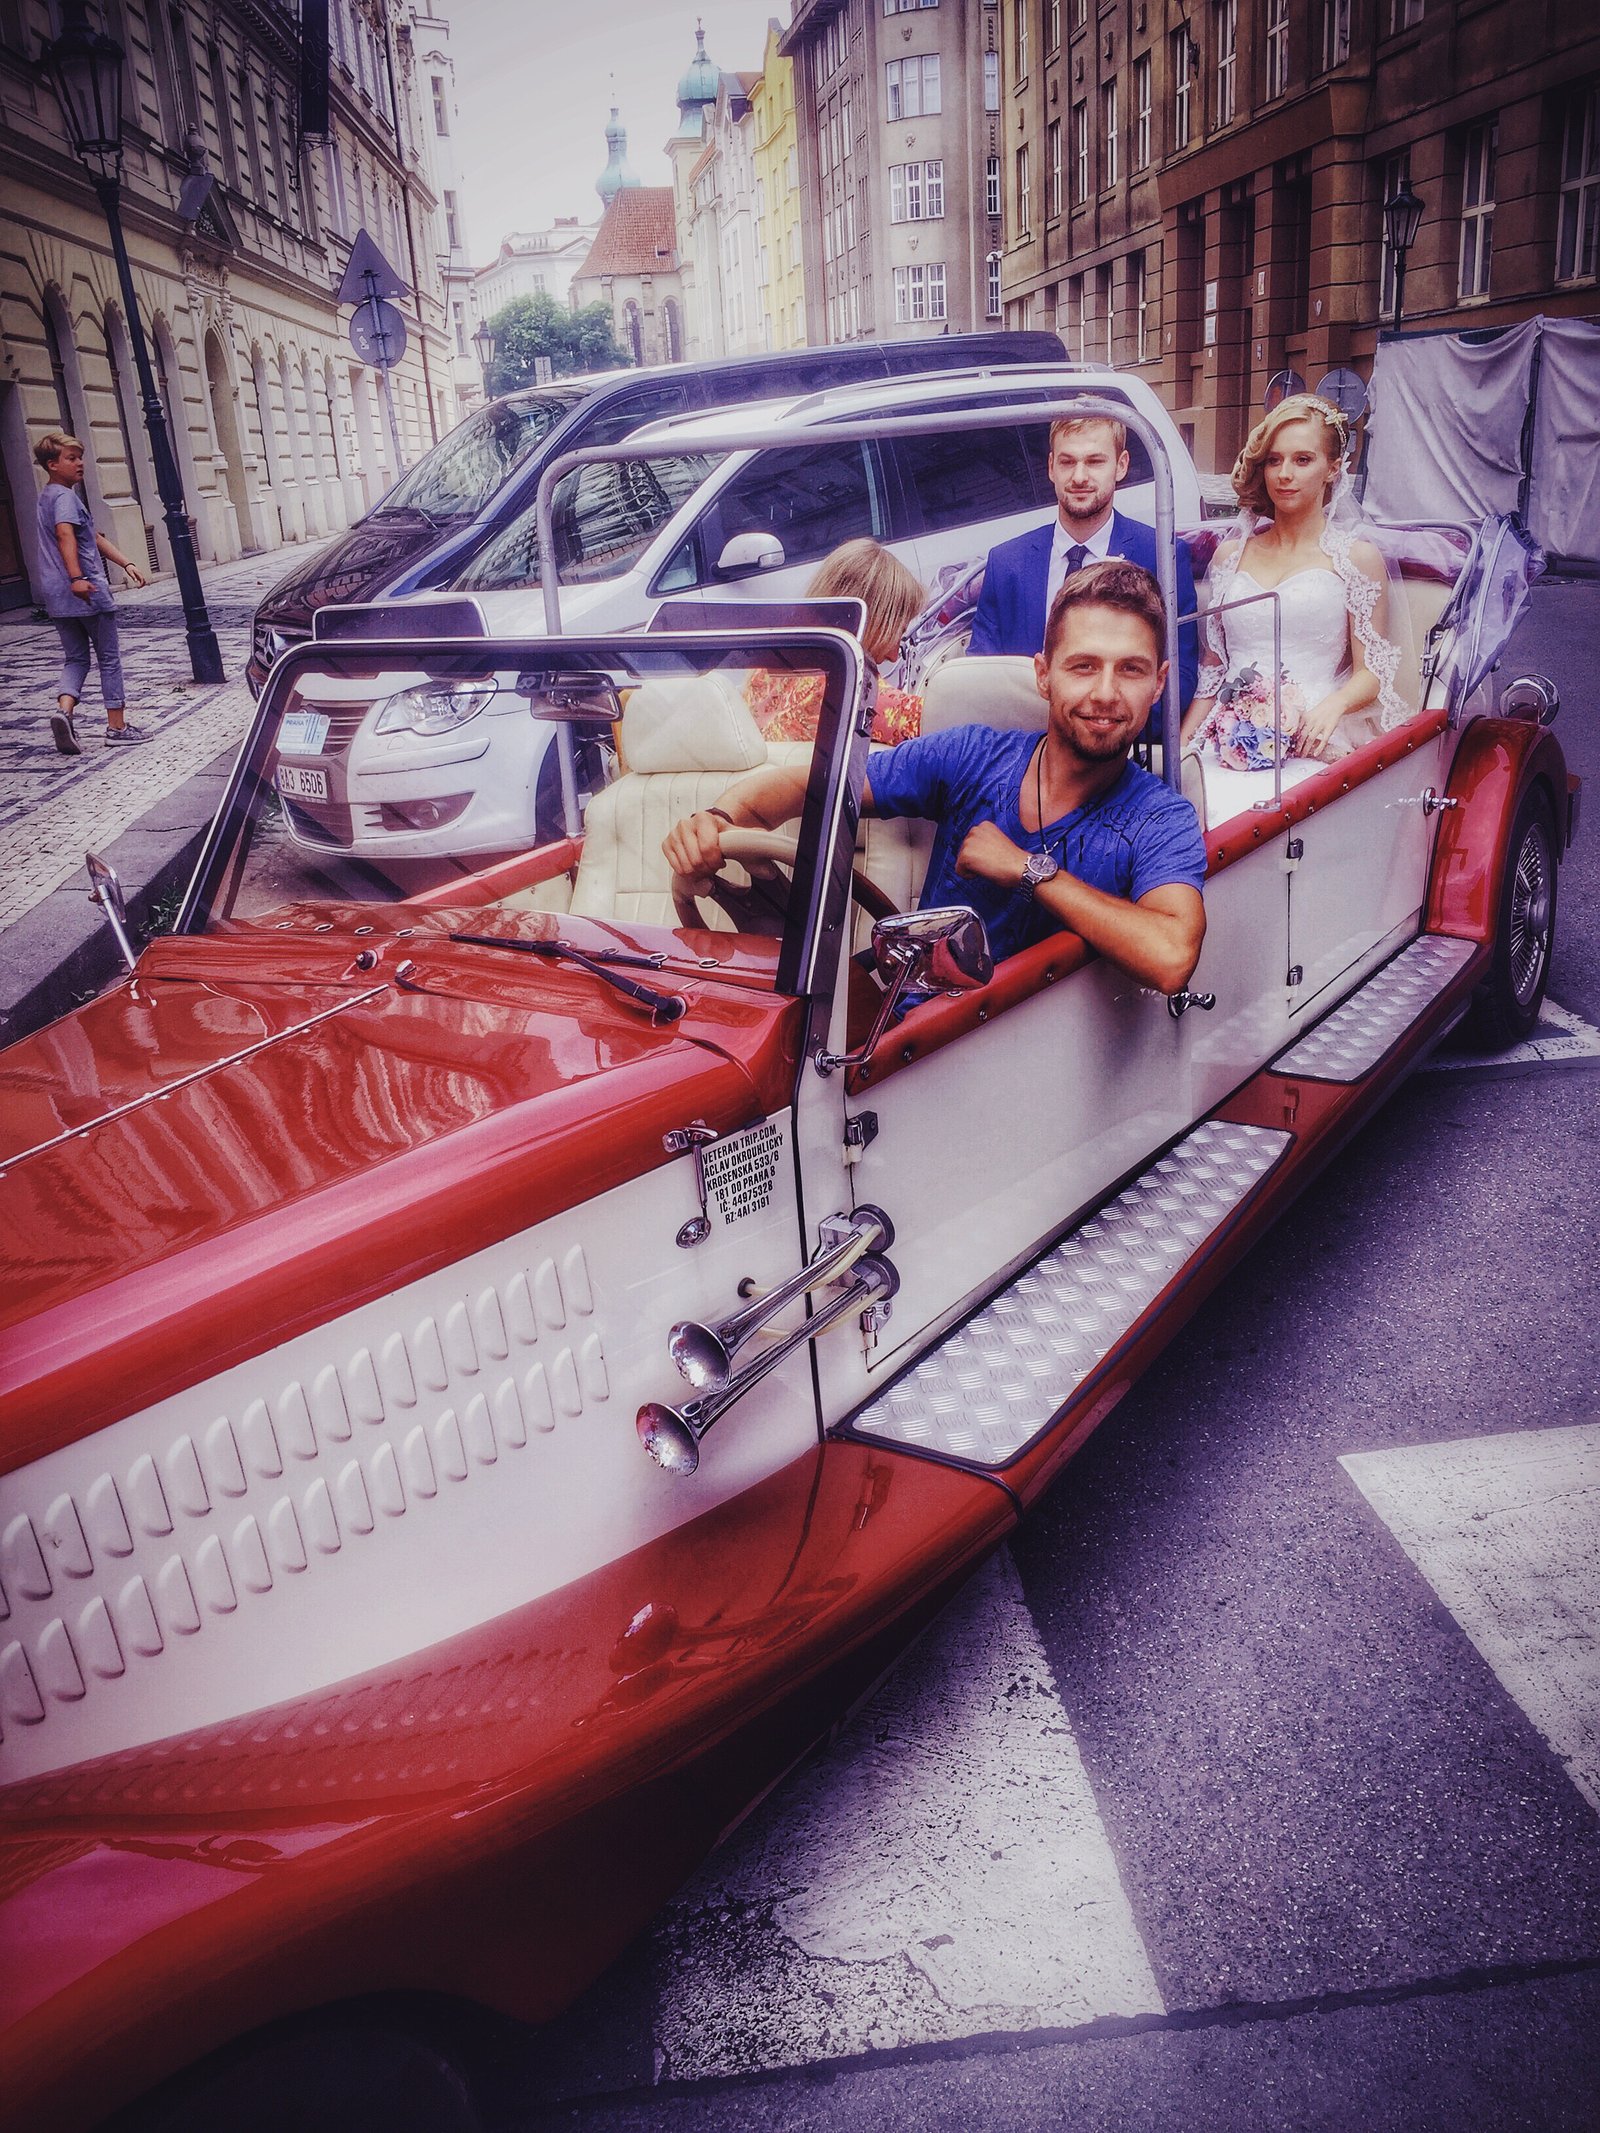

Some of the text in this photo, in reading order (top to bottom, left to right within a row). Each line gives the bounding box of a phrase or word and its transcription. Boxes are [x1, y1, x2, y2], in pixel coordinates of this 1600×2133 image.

[300, 771, 324, 795] 6506
[702, 1123, 777, 1165] VETERAN TRIP.COM
[703, 1132, 784, 1179] ÁCLAV OKROUHLICKÝ
[706, 1160, 754, 1192] KROSENSKÁ
[715, 1165, 776, 1202] 181 00 PRAHA 8
[732, 1180, 774, 1208] 44975328
[752, 1195, 770, 1213] 3191
